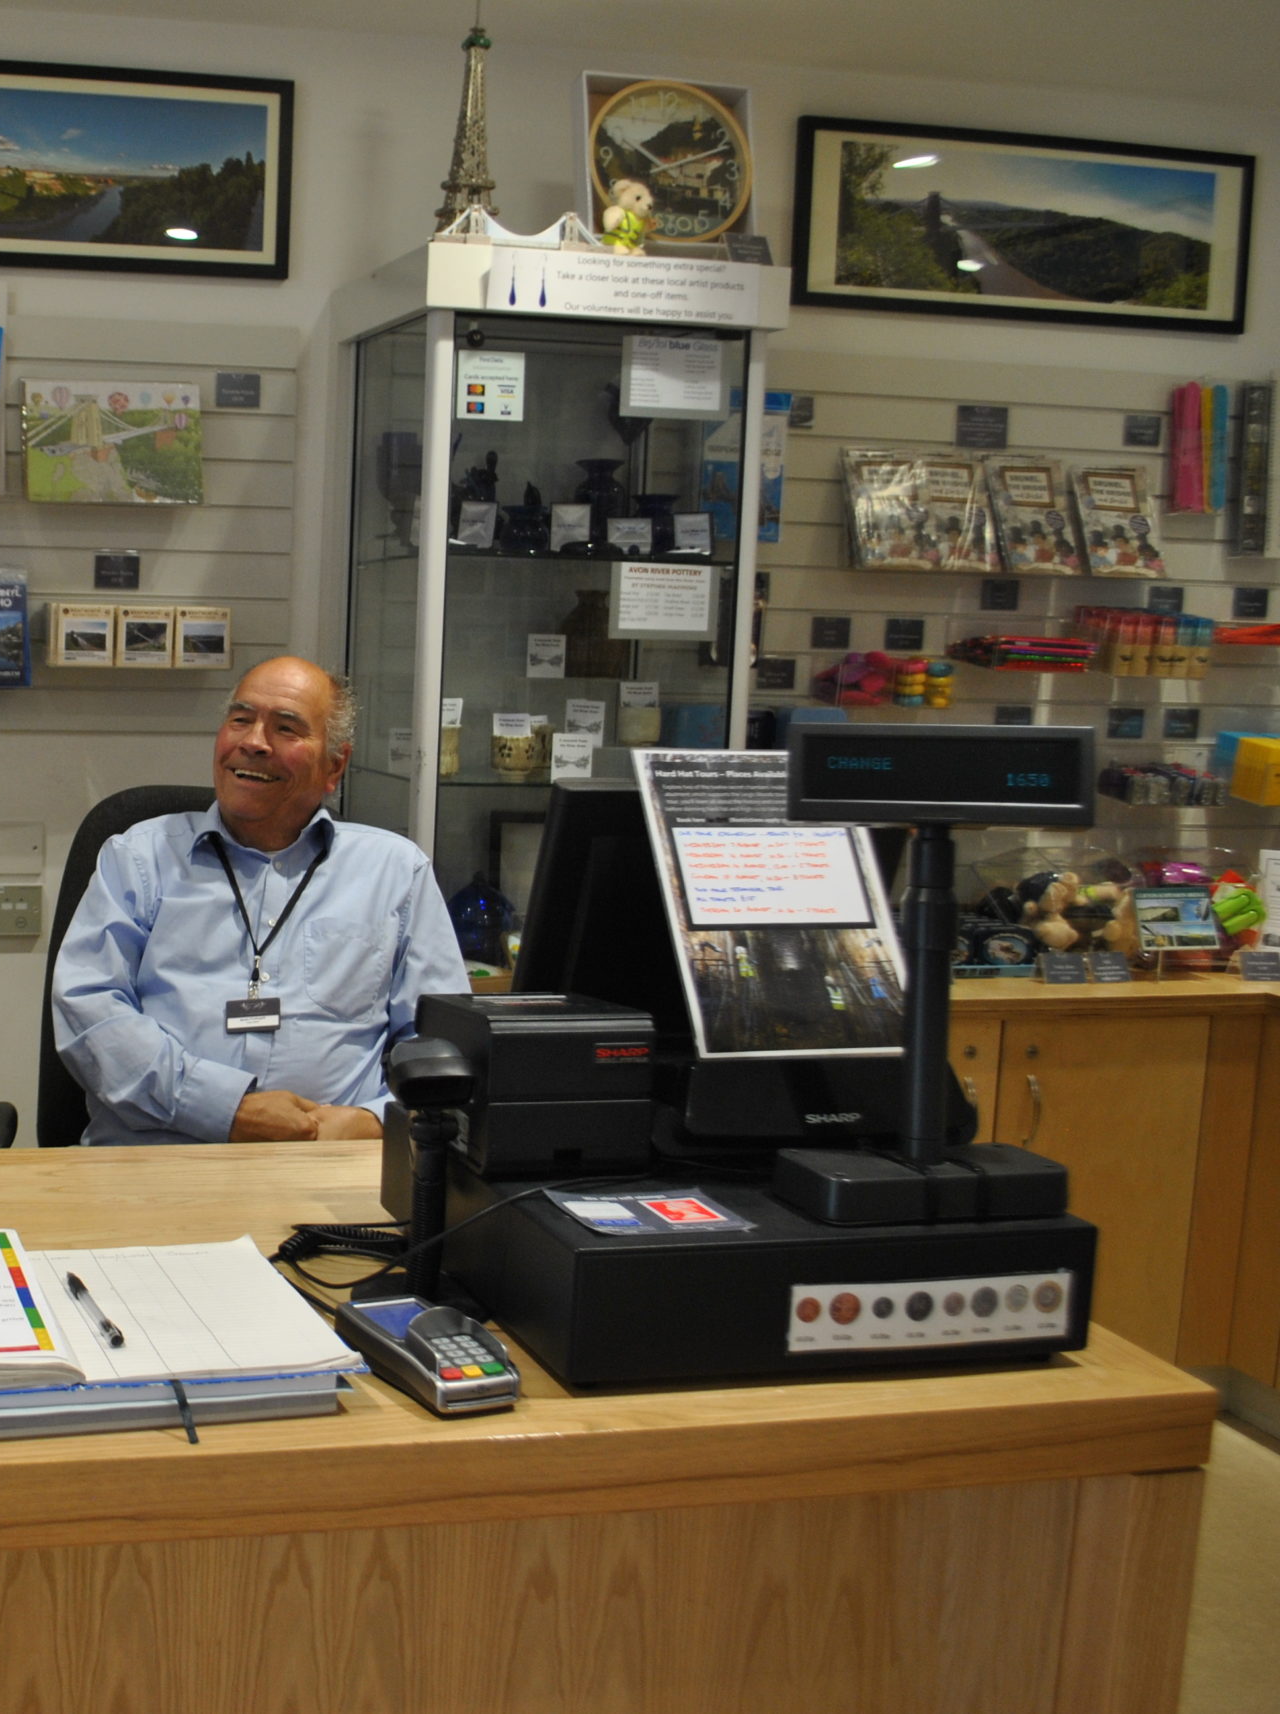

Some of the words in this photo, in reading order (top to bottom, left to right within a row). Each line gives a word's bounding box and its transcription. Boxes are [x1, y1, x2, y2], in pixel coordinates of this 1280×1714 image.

[599, 146, 613, 167] 9
[725, 160, 739, 180] 3
[577, 255, 610, 268] Looking
[612, 257, 624, 267] for
[626, 259, 671, 271] something
[673, 262, 694, 271] extra
[696, 262, 726, 274] special?
[557, 270, 576, 280] Take
[585, 273, 609, 283] closer
[611, 274, 628, 284] look
[631, 276, 639, 285] at
[641, 276, 665, 287] these
[667, 277, 686, 288] local
[688, 279, 708, 289] artist
[710, 280, 744, 292] products
[613, 288, 629, 298] and
[631, 289, 662, 299] one-off
[664, 291, 689, 301] items.
[564, 302, 580, 311] Our
[582, 302, 625, 314] volunteers
[627, 304, 641, 314] will
[643, 306, 654, 315] be
[656, 306, 682, 319] happy
[684, 308, 693, 317] to
[695, 309, 716, 319] assist
[650, 567, 671, 576] RIVER
[671, 568, 703, 577] POTTERY
[826, 755, 894, 770] CHANGE
[655, 769, 676, 778] Hard
[677, 769, 693, 778] Hat
[693, 769, 718, 778] Tours
[726, 769, 752, 778] Places
[753, 769, 787, 778] Availabl
[595, 1047, 650, 1058] SHARP
[805, 1112, 861, 1125] SHARP
